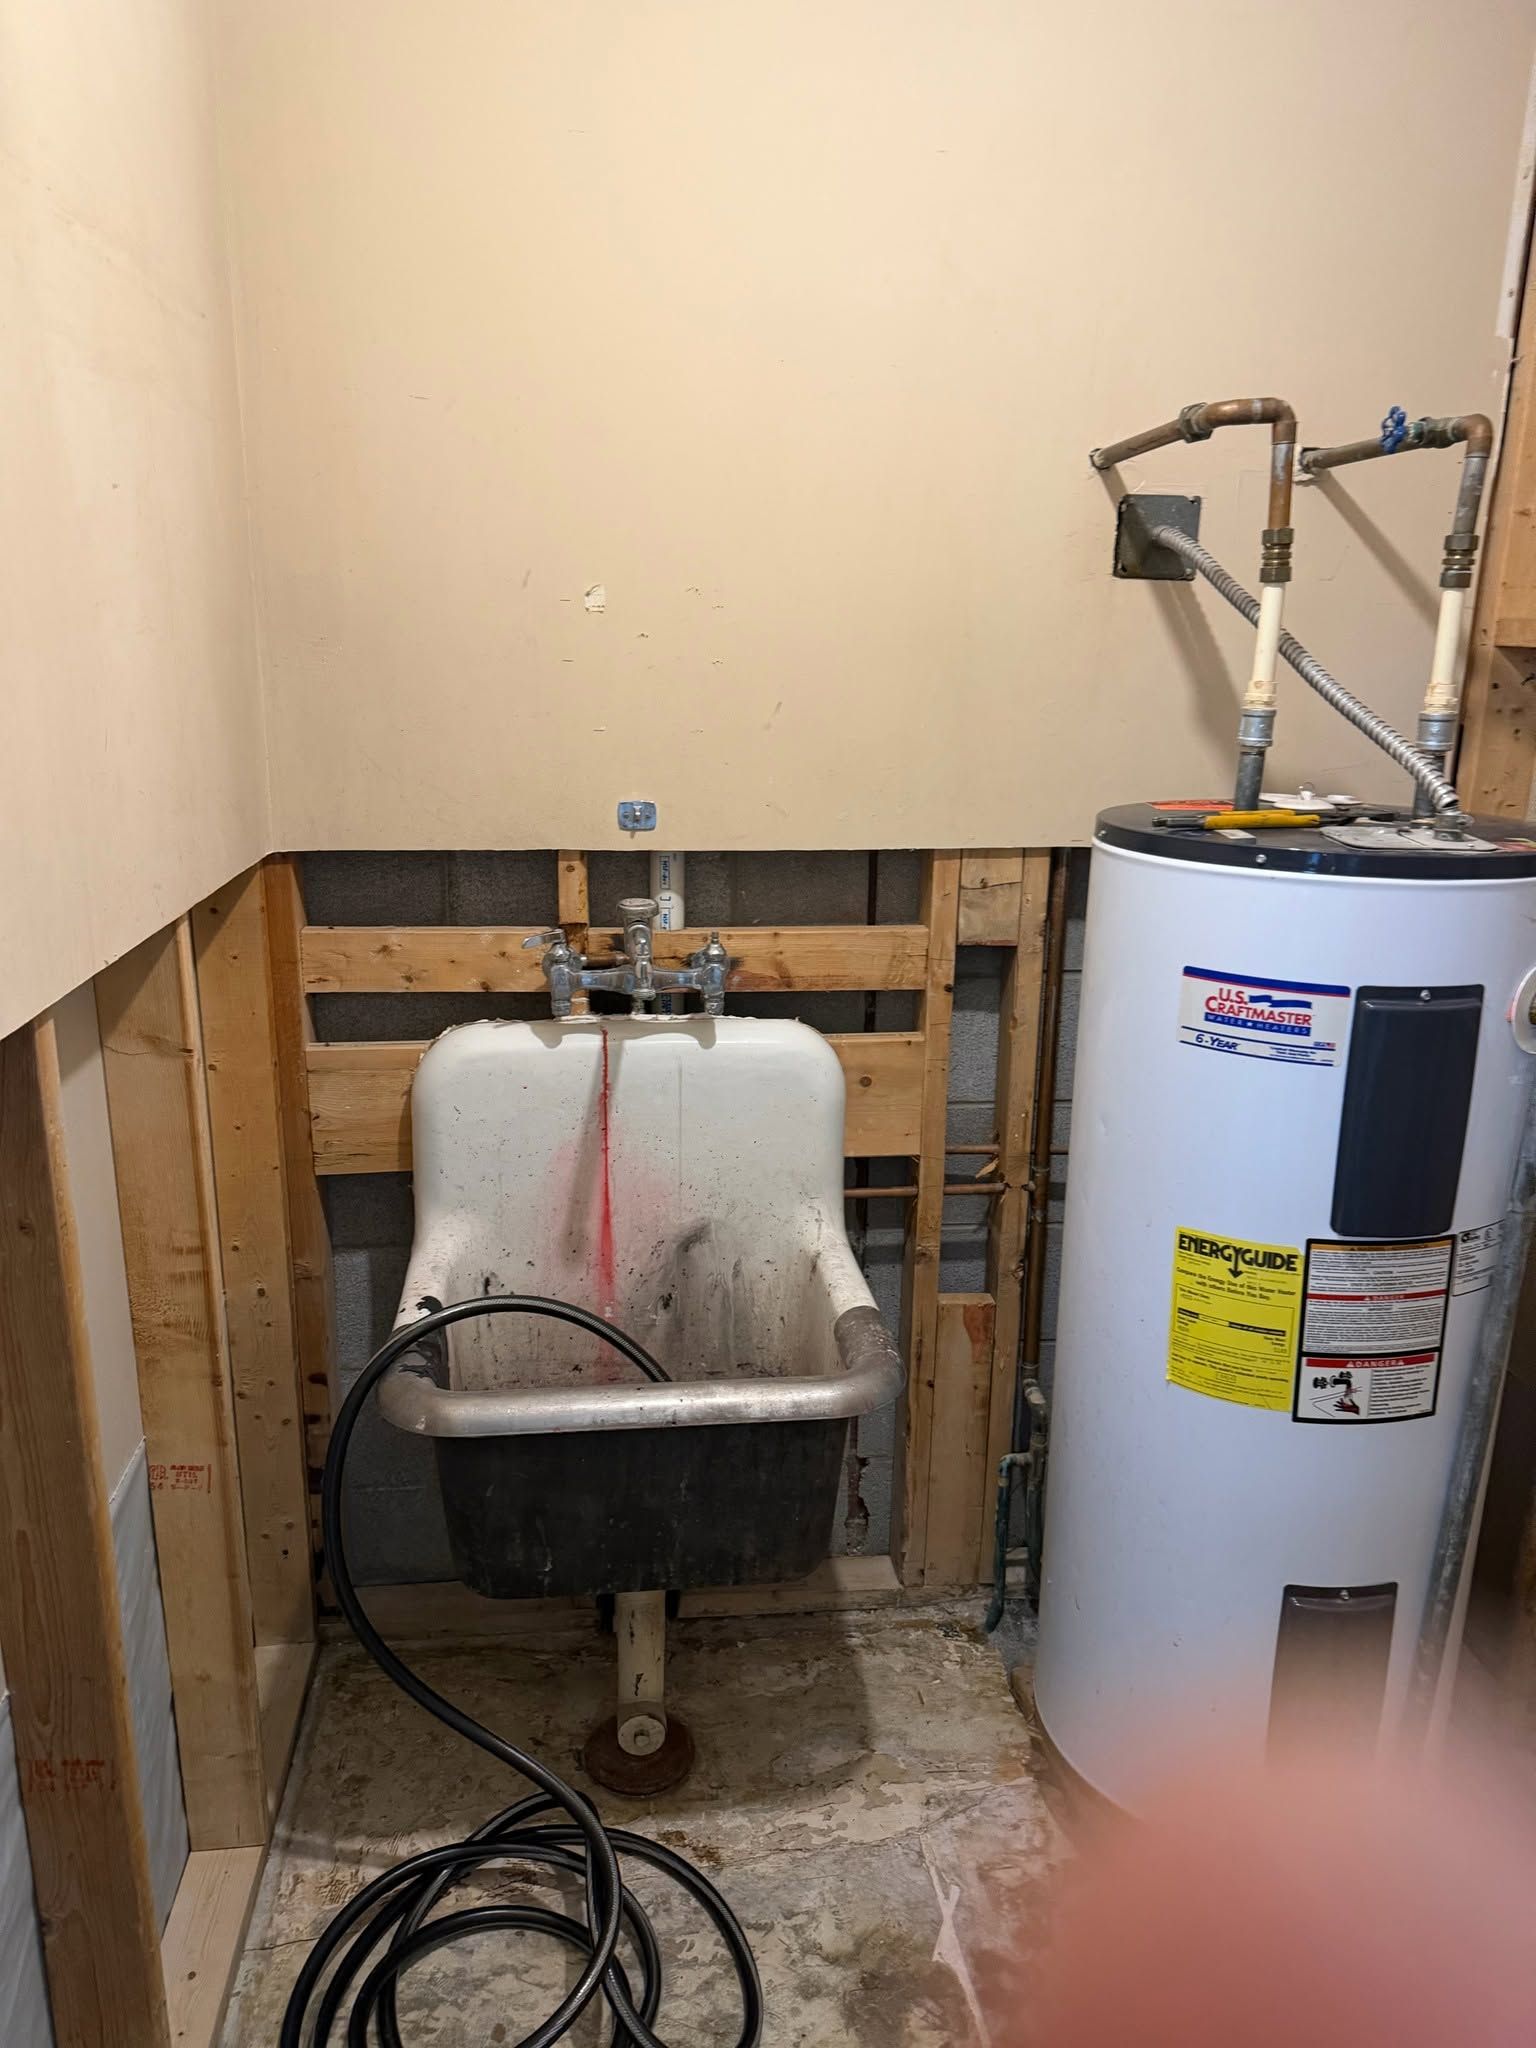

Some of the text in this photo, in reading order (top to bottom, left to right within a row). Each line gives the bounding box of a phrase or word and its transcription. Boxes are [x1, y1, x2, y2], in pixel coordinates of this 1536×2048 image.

[1218, 987, 1249, 1005] U.S.
[1204, 996, 1313, 1027] CRAFTMASTER
[1206, 1014, 1309, 1036] WATER HEATERS
[1178, 1233, 1299, 1273] ENERGYGUIDE
[1355, 1360, 1398, 1368] DANGER
